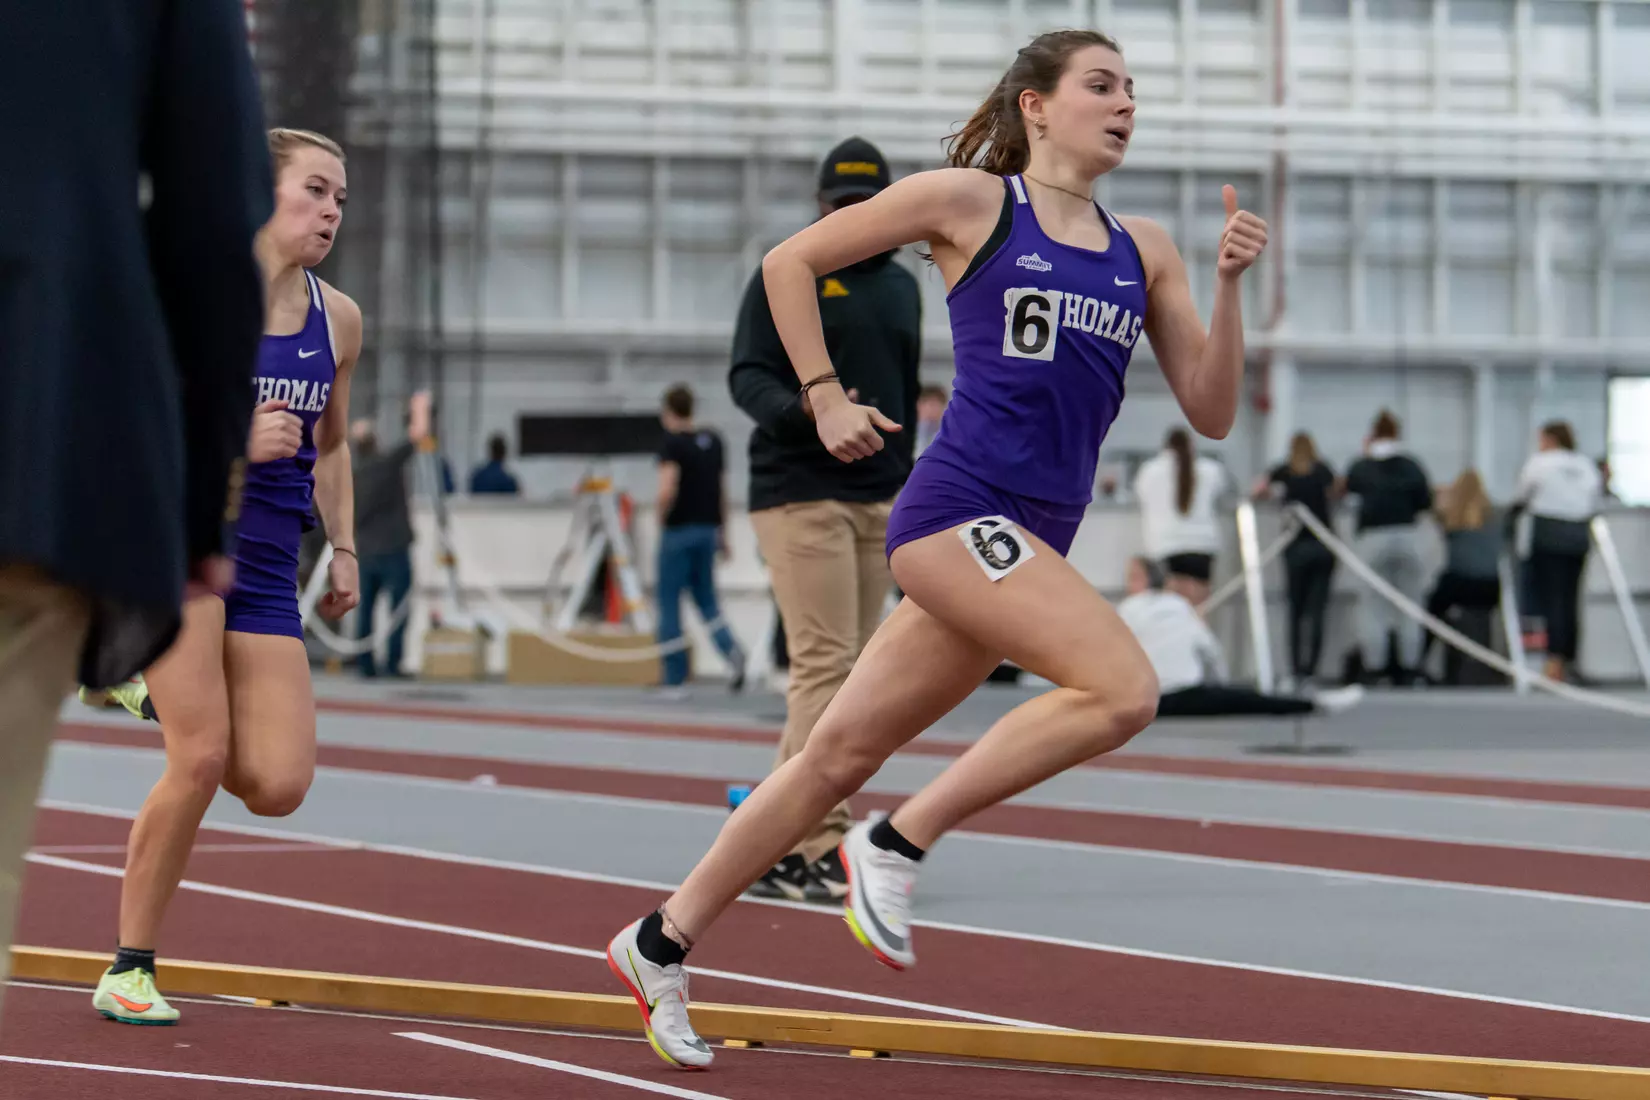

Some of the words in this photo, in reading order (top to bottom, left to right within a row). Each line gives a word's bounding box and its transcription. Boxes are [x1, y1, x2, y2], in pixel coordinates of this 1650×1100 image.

[1018, 258, 1051, 270] SUMMIT
[1012, 294, 1051, 354] 6
[1050, 289, 1142, 349] HOMAS
[251, 376, 330, 412] HOMAS
[971, 520, 1021, 570] 6
